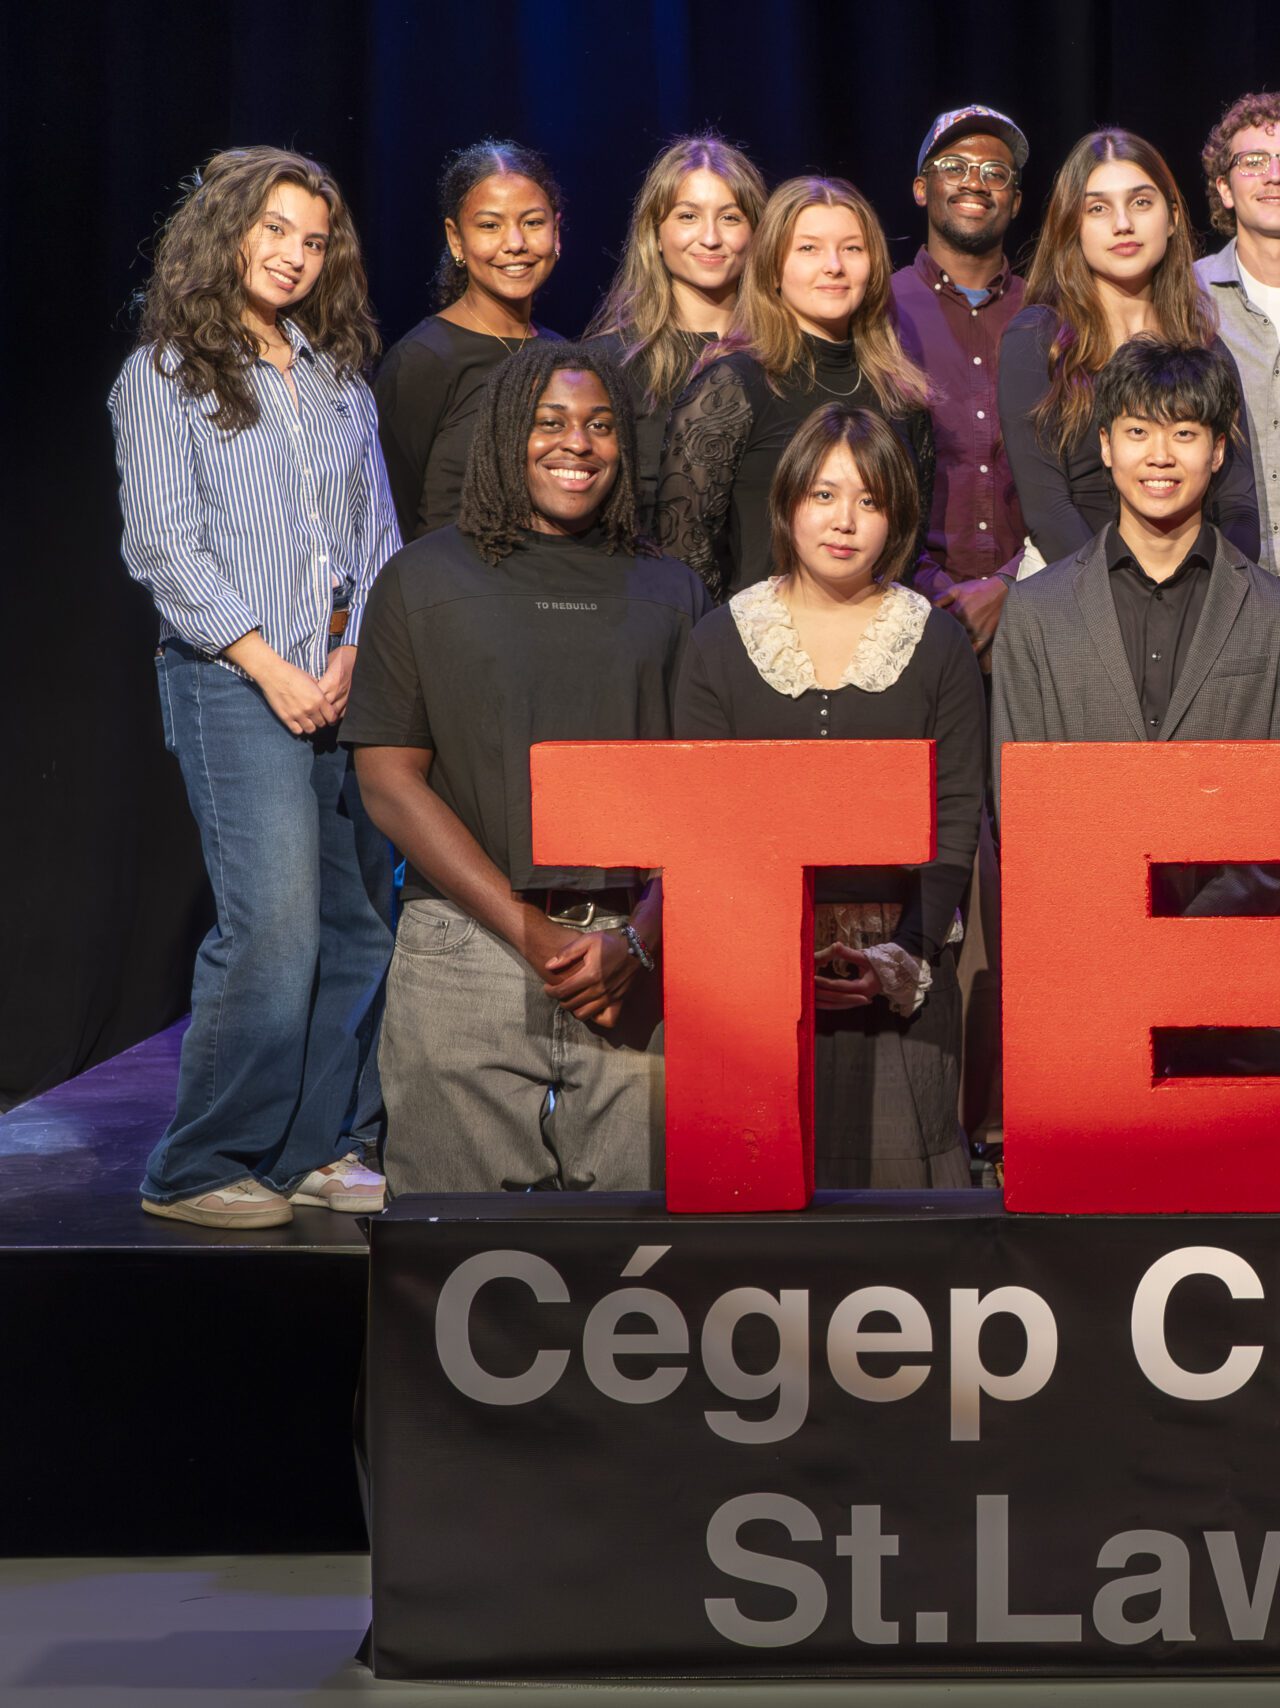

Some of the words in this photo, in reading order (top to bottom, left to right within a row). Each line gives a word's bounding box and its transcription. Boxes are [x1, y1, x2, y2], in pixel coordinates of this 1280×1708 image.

[536, 601, 549, 609] TO
[552, 602, 597, 610] REBUILD
[434, 1244, 1059, 1445] Cégep
